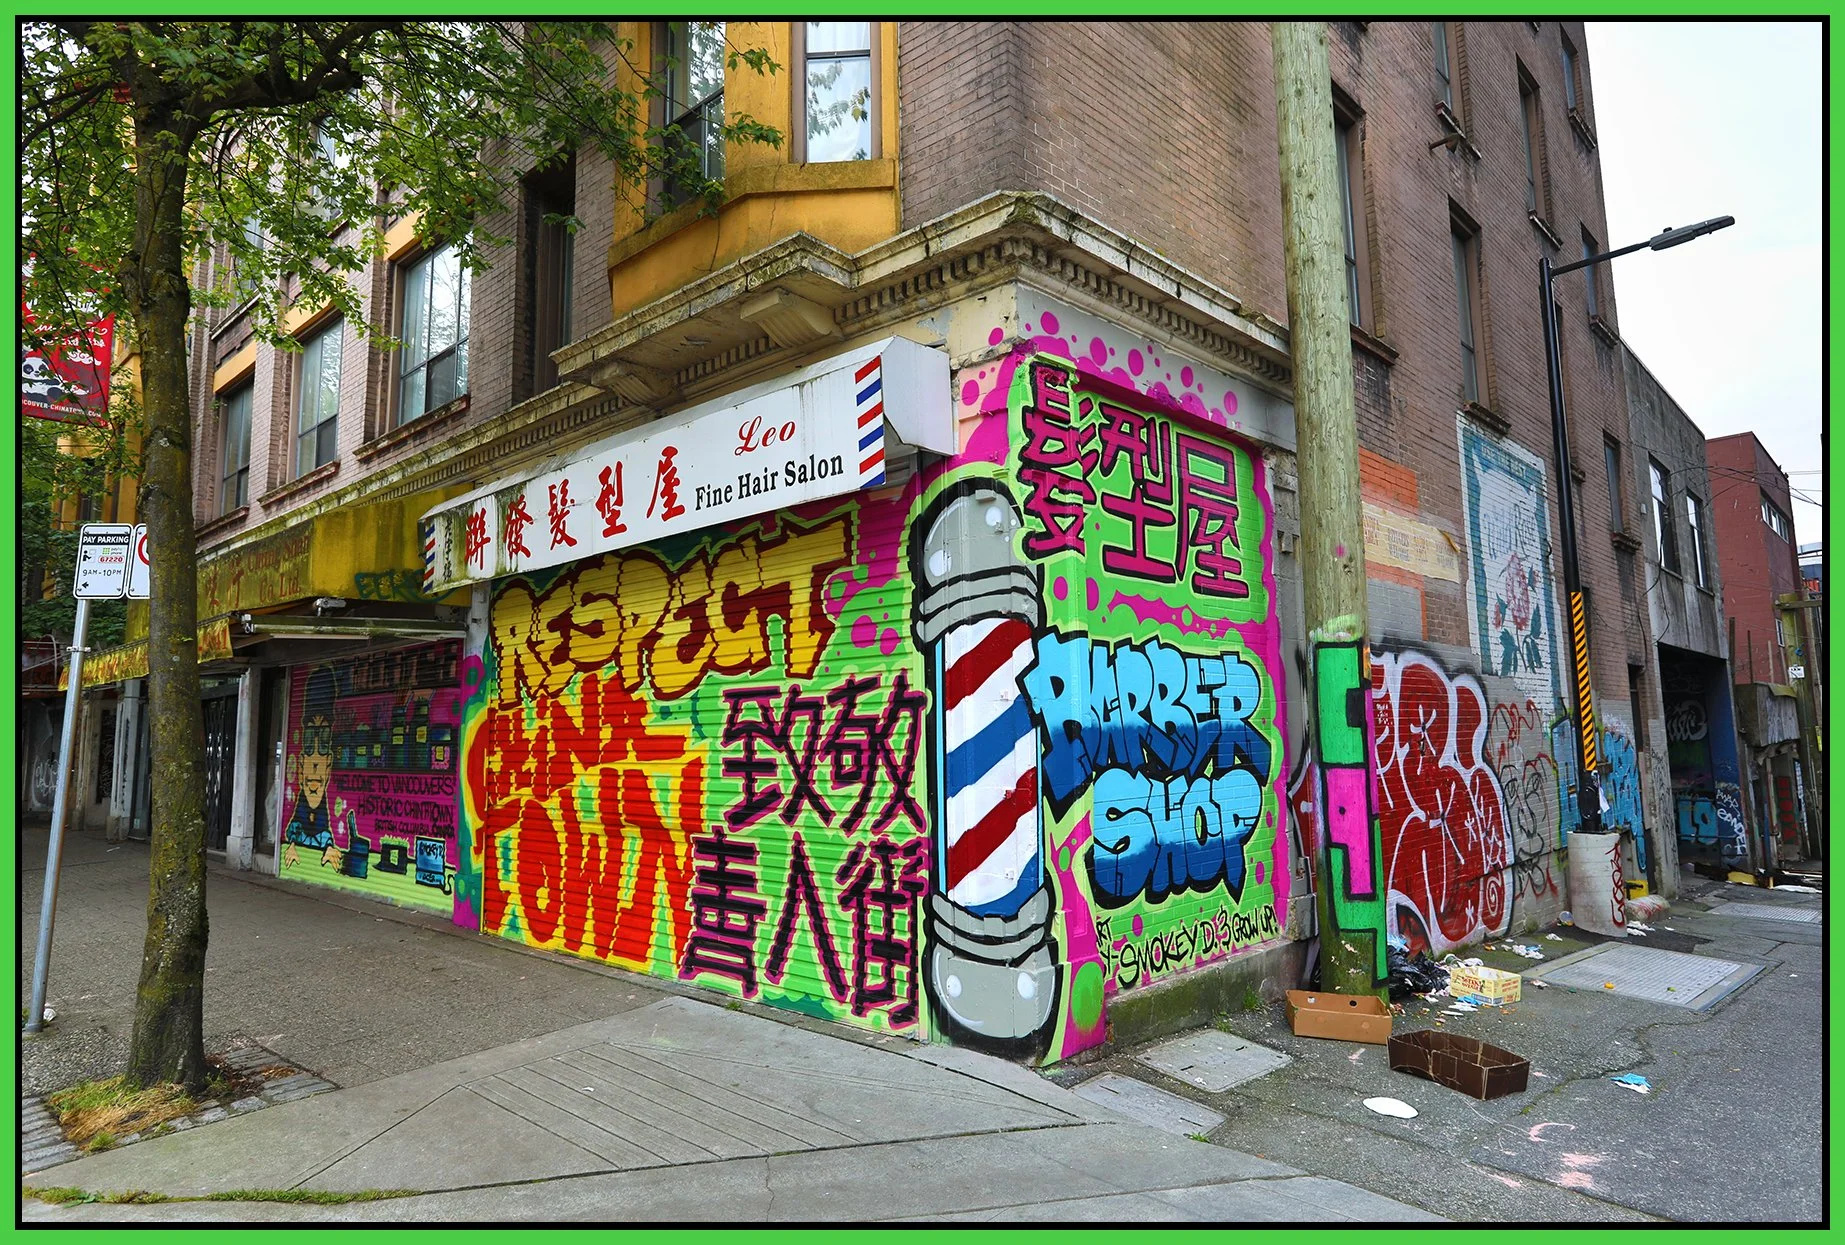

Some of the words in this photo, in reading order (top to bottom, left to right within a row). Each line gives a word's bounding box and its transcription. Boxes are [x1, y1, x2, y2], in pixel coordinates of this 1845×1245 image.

[734, 415, 796, 456] Leo
[695, 483, 733, 511] Fine
[738, 467, 778, 499] Hair
[784, 453, 844, 487] Salon
[491, 517, 856, 711] RESPECT
[333, 774, 376, 792] WELCOME
[376, 775, 390, 793] TO
[357, 794, 402, 816] HISTORIC
[484, 757, 703, 963] TOWN
[1091, 767, 1264, 909] SHOP
[1232, 909, 1260, 943] GROW
[1261, 905, 1279, 935] UP!
